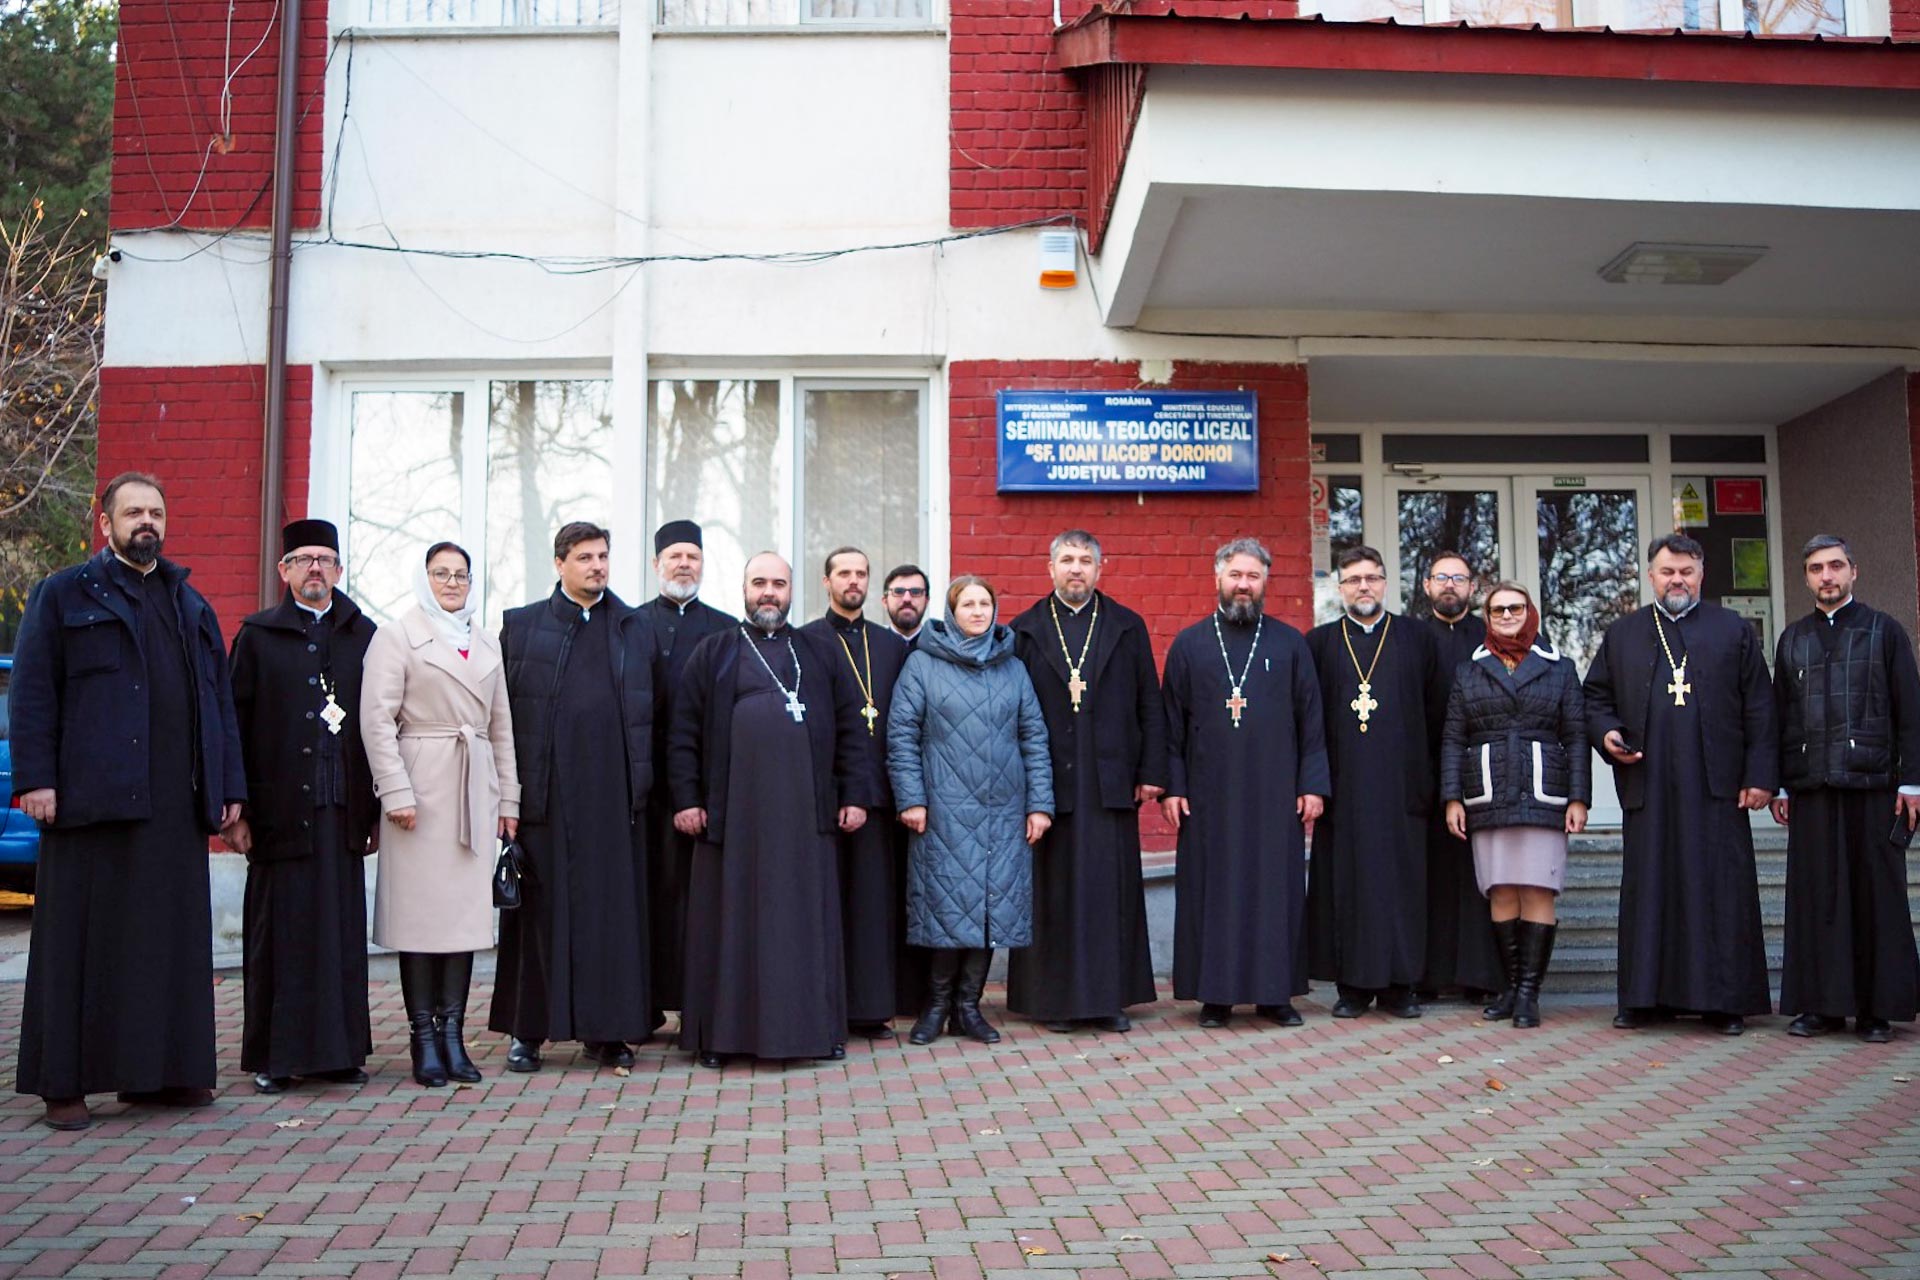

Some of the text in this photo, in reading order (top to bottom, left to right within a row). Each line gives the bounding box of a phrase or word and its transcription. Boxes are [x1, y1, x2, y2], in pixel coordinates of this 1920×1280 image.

[1105, 397, 1152, 406] ROMÂNIA
[1006, 421, 1251, 440] SEMINARUL TEOLOGIC LICEAL
[1059, 444, 1097, 462] IOAN
[1161, 444, 1232, 462] DOROHOI
